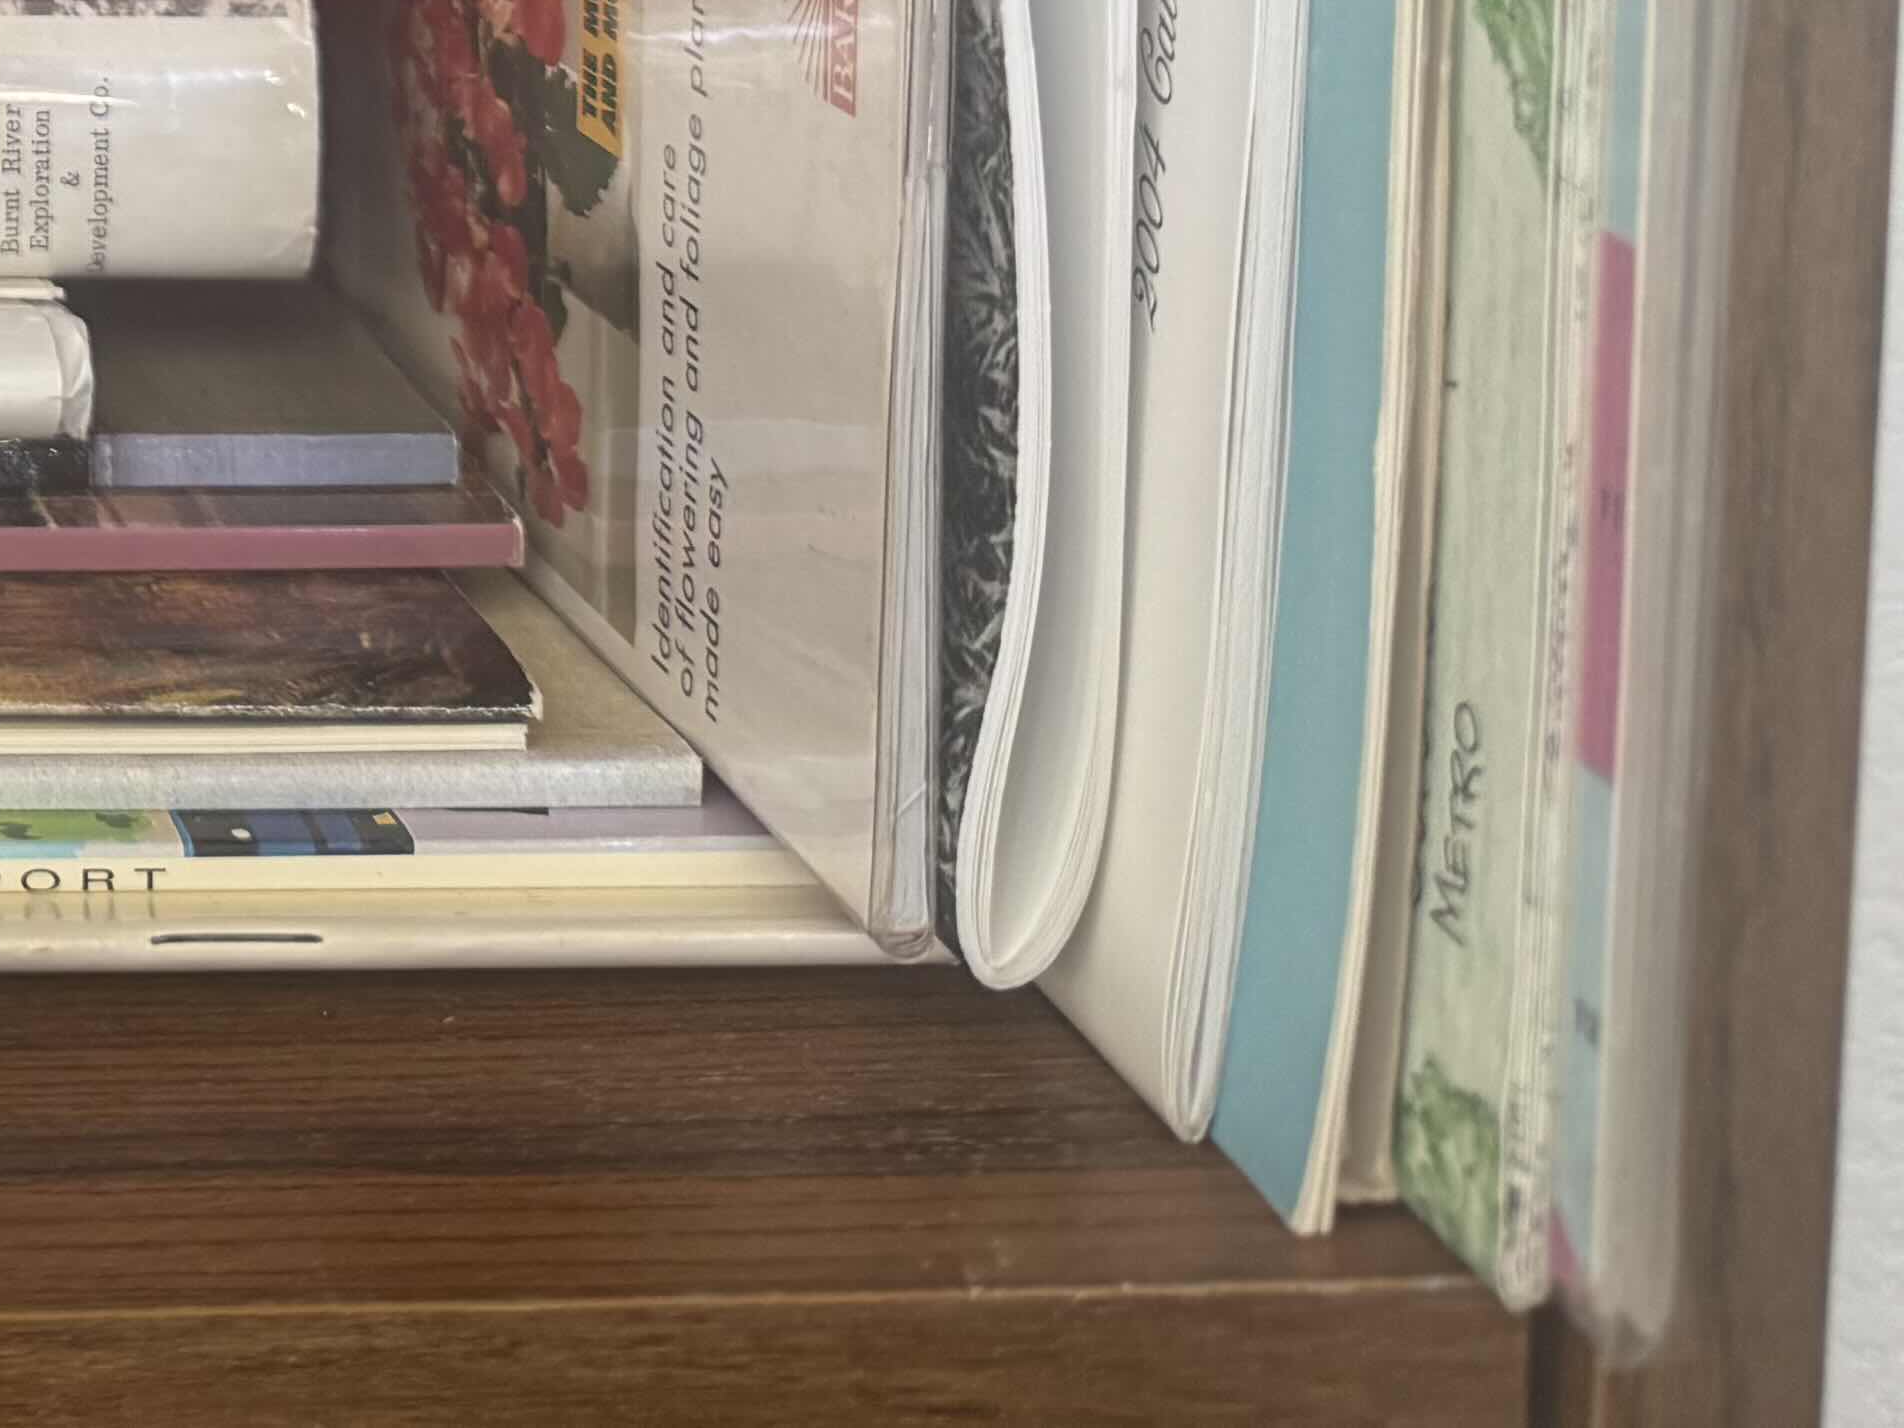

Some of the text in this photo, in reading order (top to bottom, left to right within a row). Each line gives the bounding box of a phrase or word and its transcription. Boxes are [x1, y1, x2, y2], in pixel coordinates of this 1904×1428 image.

[582, 48, 599, 120] THE
[599, 54, 618, 136] AND
[0, 103, 25, 257] Burnt River
[29, 108, 53, 253] Exploration
[61, 168, 81, 188] &
[680, 110, 707, 283] foliage
[1132, 120, 1168, 333] 2004
[652, 144, 678, 675] Identification and care
[681, 296, 701, 394] and
[674, 412, 704, 630] flowering
[700, 456, 730, 724] made easy
[676, 638, 696, 698] of
[1427, 698, 1484, 947] METRO
